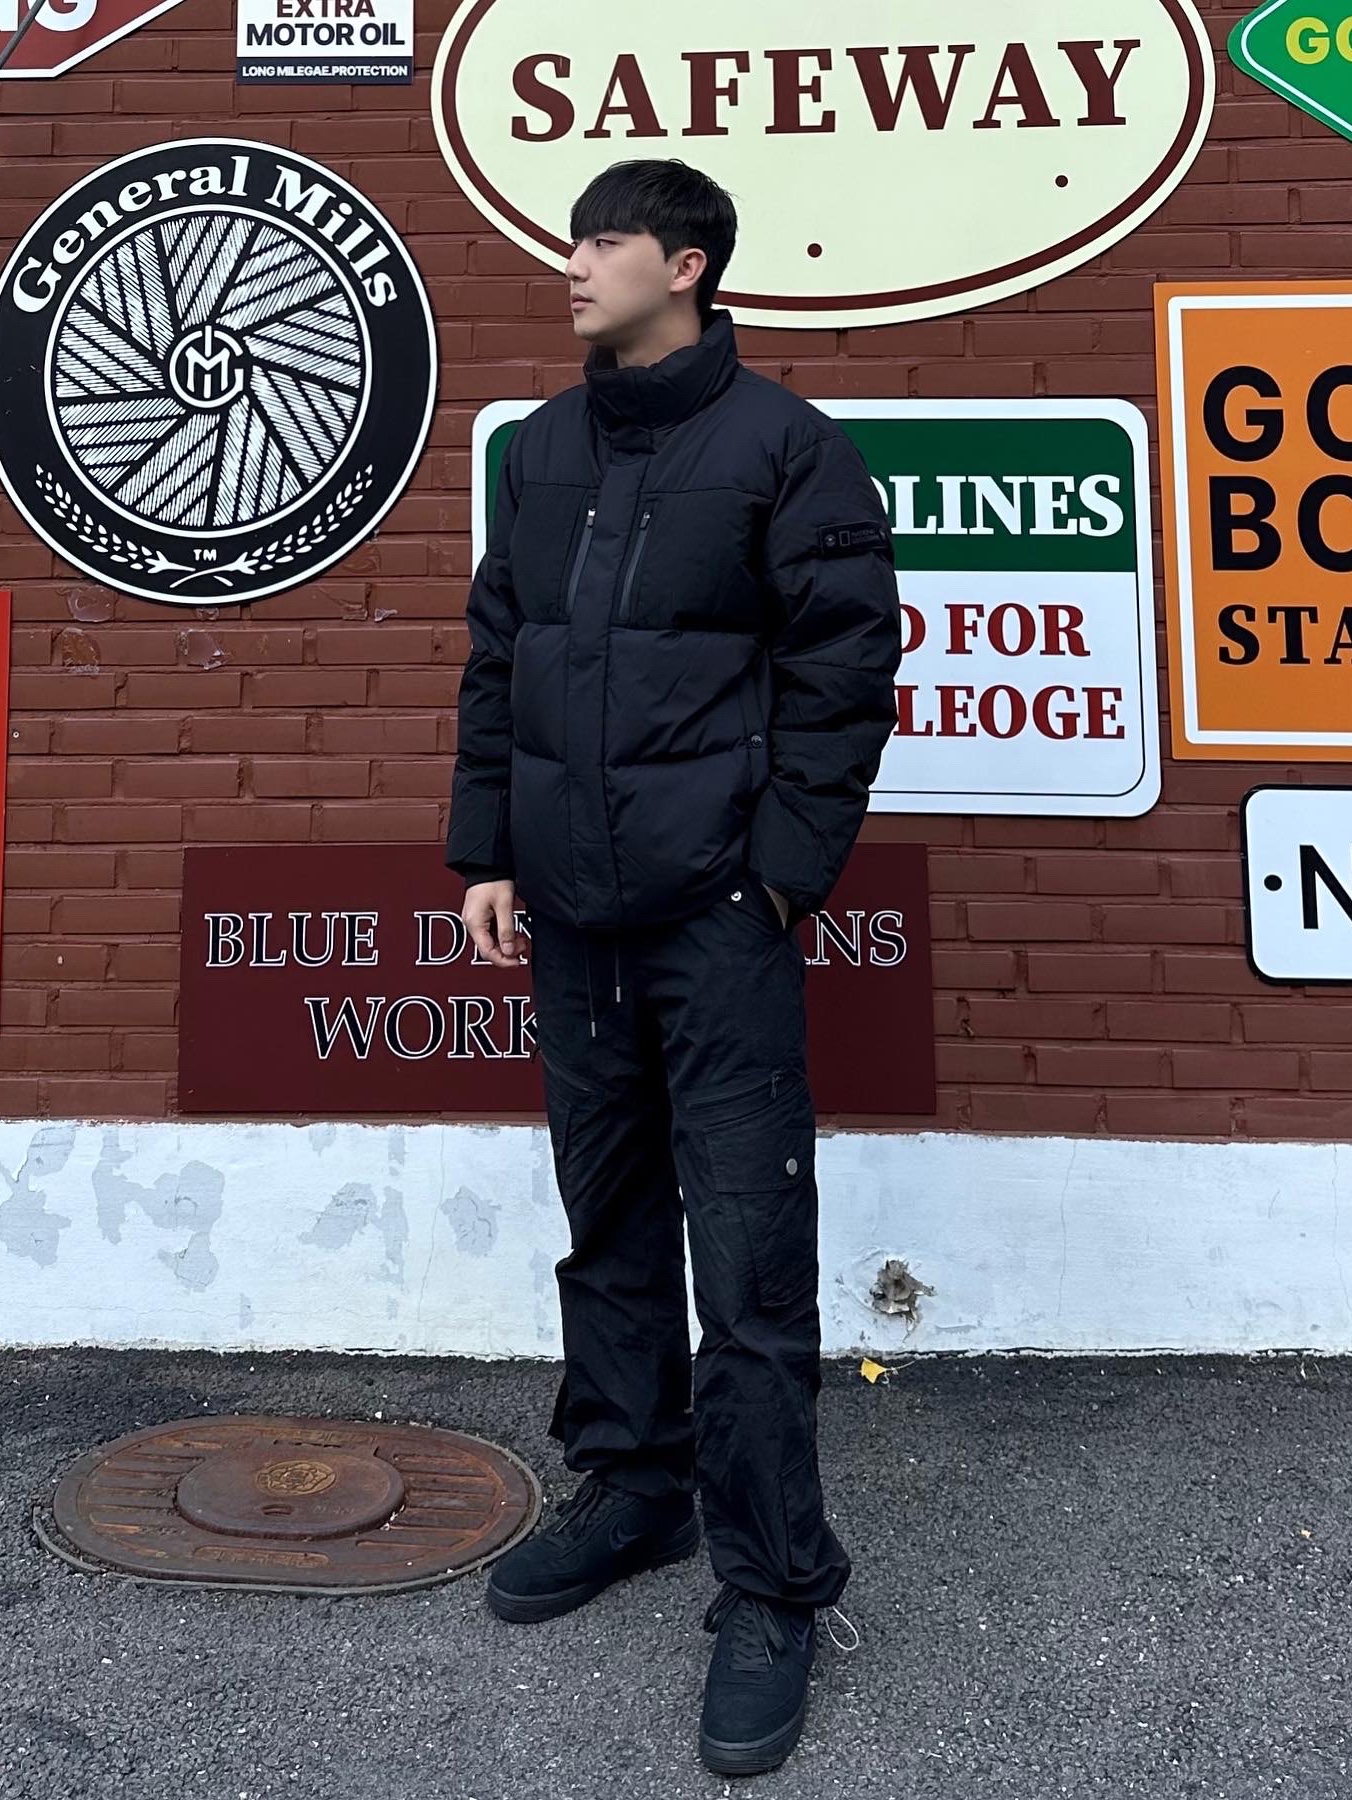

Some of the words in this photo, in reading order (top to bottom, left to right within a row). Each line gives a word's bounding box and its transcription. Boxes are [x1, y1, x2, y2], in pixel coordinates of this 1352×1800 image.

[246, 23, 355, 46] MOTOR
[360, 22, 406, 46] OIL
[276, 0, 376, 18] EXTRA
[242, 66, 275, 77] LONG
[511, 39, 1141, 142] SAFEWAY
[12, 155, 251, 313] General
[264, 164, 398, 307] Mills
[1208, 474, 1352, 573] BO
[193, 549, 217, 561] TM
[944, 602, 1091, 657] FOR
[204, 911, 379, 967] BLUE
